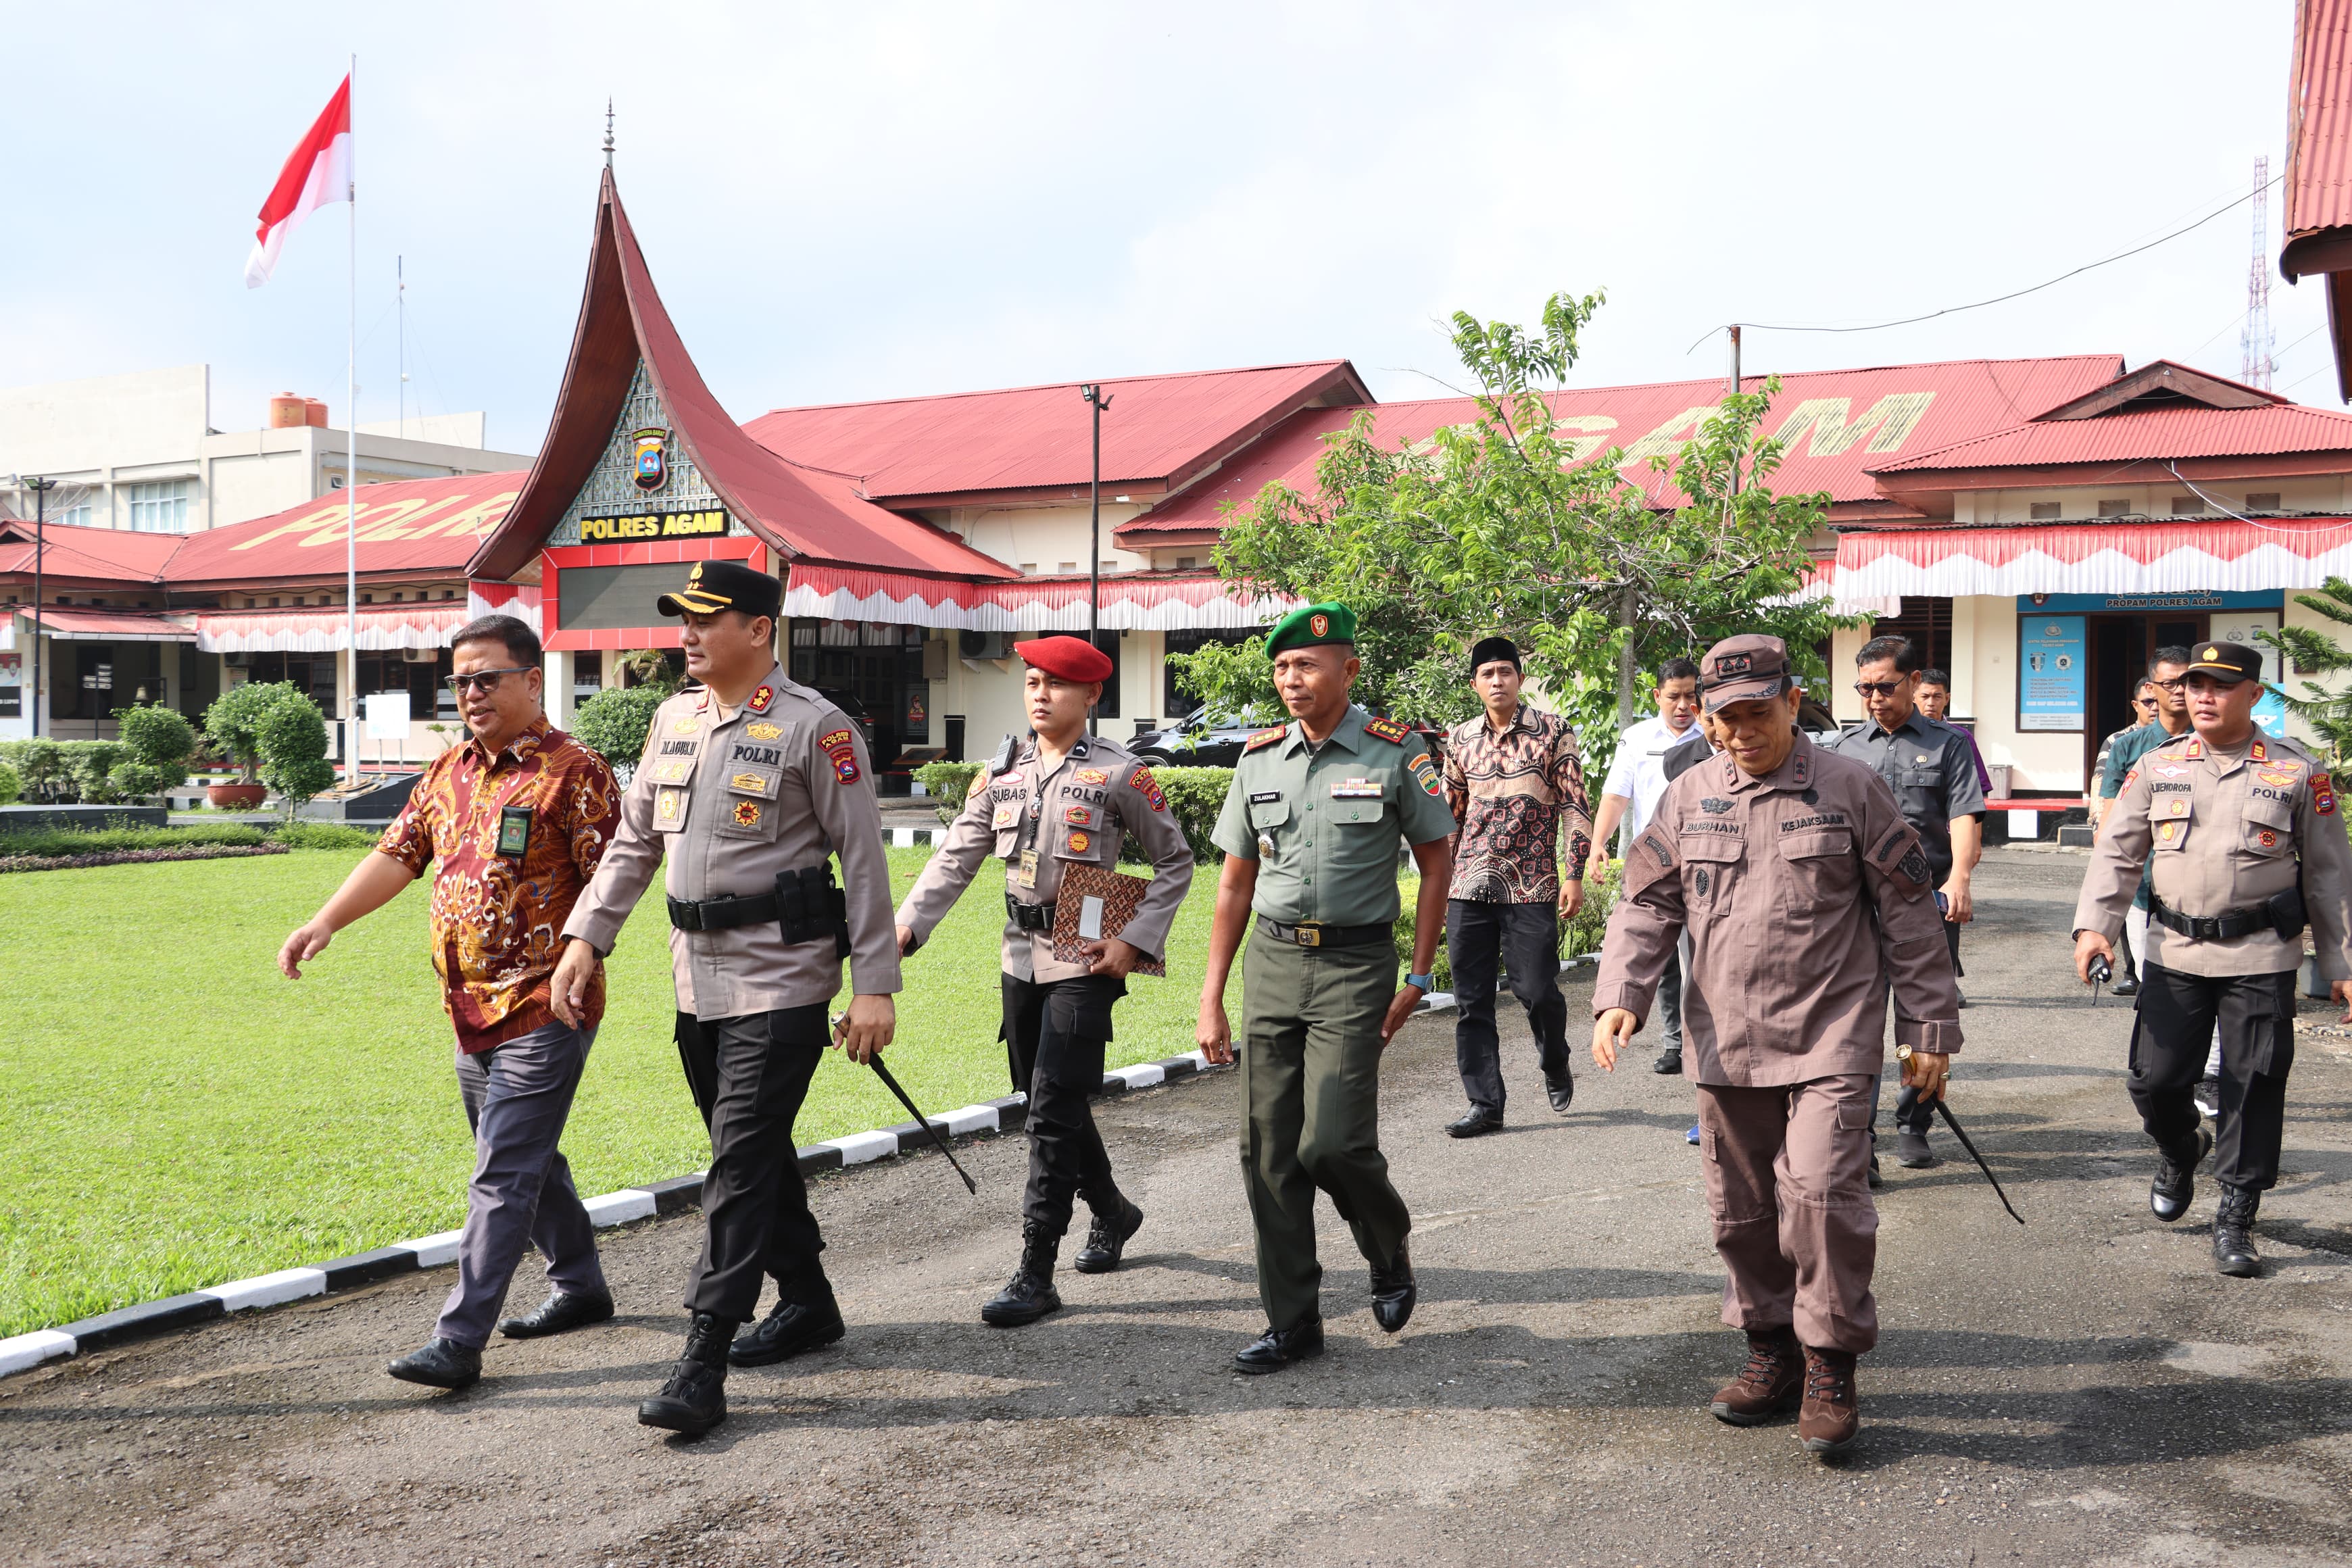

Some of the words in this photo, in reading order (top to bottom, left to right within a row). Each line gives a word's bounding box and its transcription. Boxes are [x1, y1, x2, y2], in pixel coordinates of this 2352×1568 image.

[633, 429, 652, 439] SUMATERA
[652, 429, 666, 439] BARAT
[581, 516, 660, 540] POLRES
[662, 512, 724, 536] AGAM
[2107, 599, 2147, 608] PROPAM
[2150, 598, 2189, 607] POLRES
[2192, 597, 2222, 606] AGAM
[733, 745, 781, 765] POLRI
[991, 787, 1027, 802] SUBAS
[1061, 785, 1110, 805] POLRI
[2252, 787, 2293, 805] POLRI
[1685, 822, 1740, 835] BURHAN
[1780, 814, 1845, 833] KEJAKSAAN
